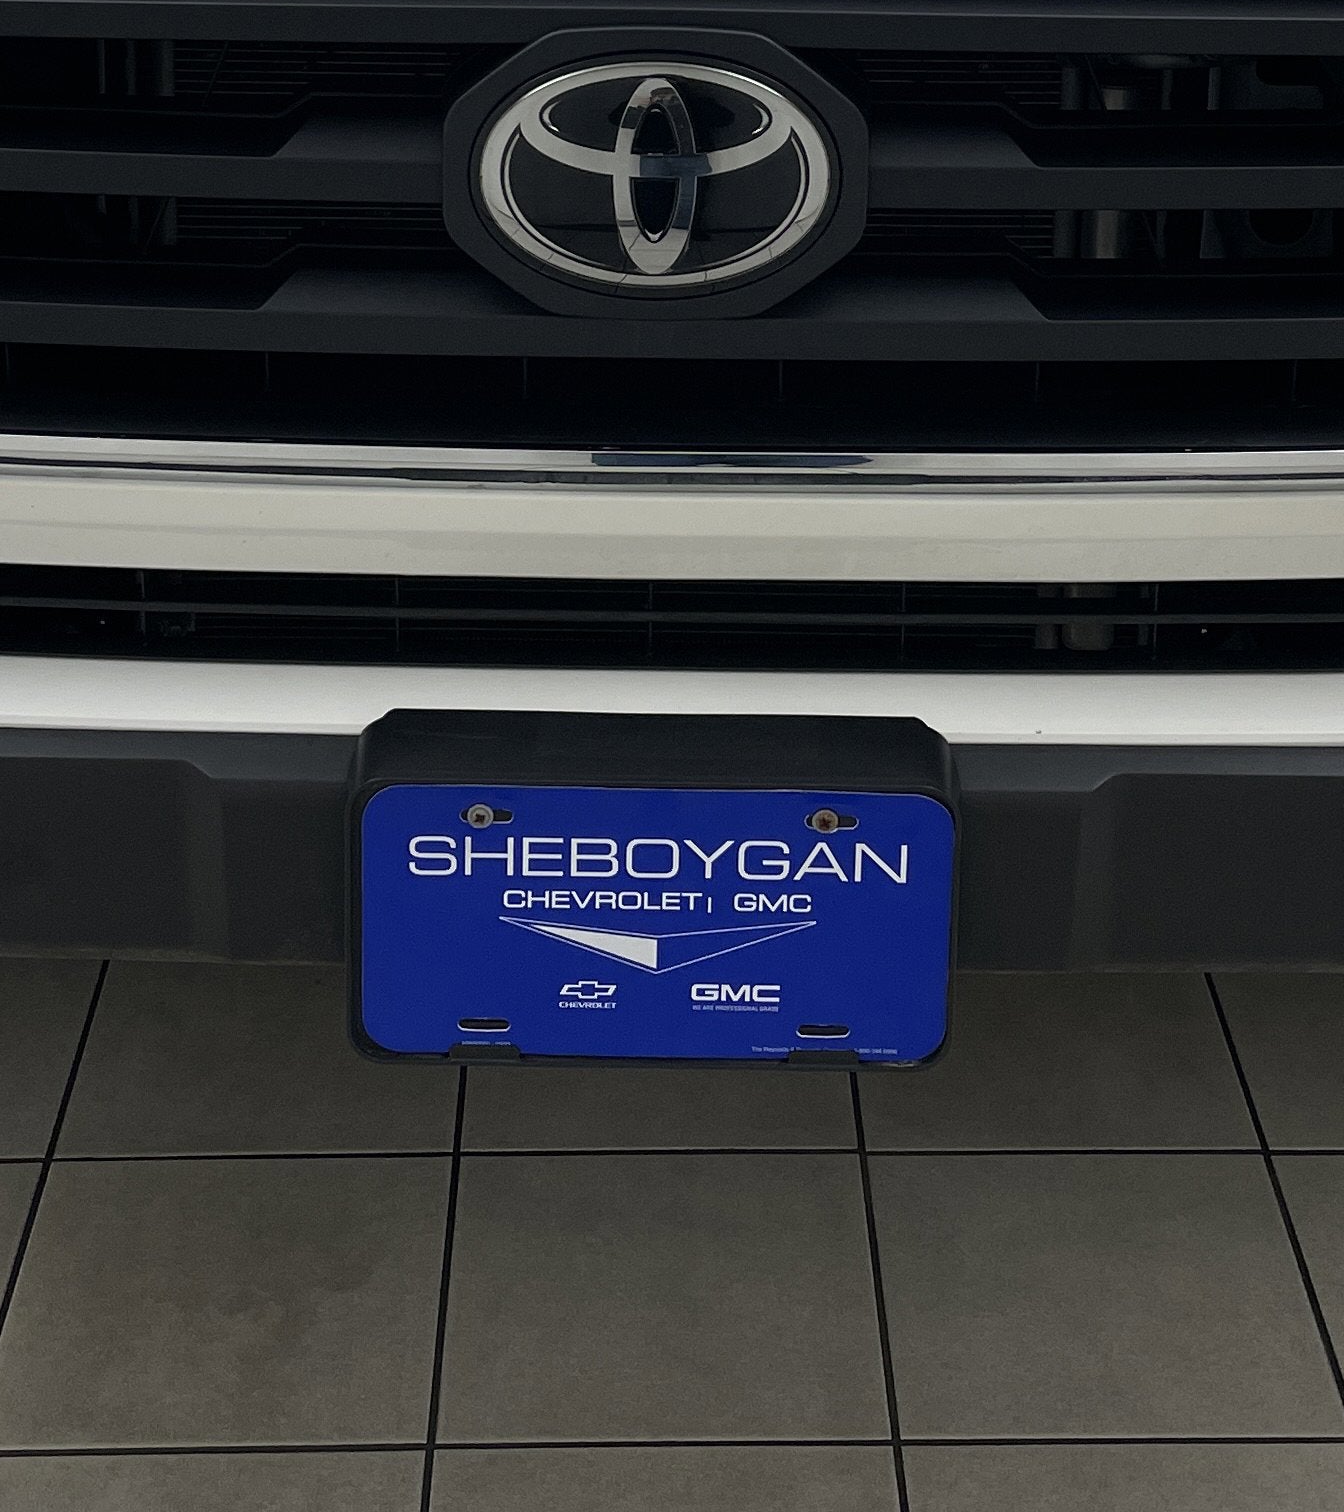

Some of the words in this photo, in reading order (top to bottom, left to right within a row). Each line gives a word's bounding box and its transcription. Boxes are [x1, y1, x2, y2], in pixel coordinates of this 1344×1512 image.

[408, 835, 908, 884] SHEBOYGAN
[502, 889, 703, 912] CHEVROLET
[733, 893, 812, 914] GMC
[690, 983, 781, 1003] GMC
[558, 1001, 617, 1009] CHEVROLET
